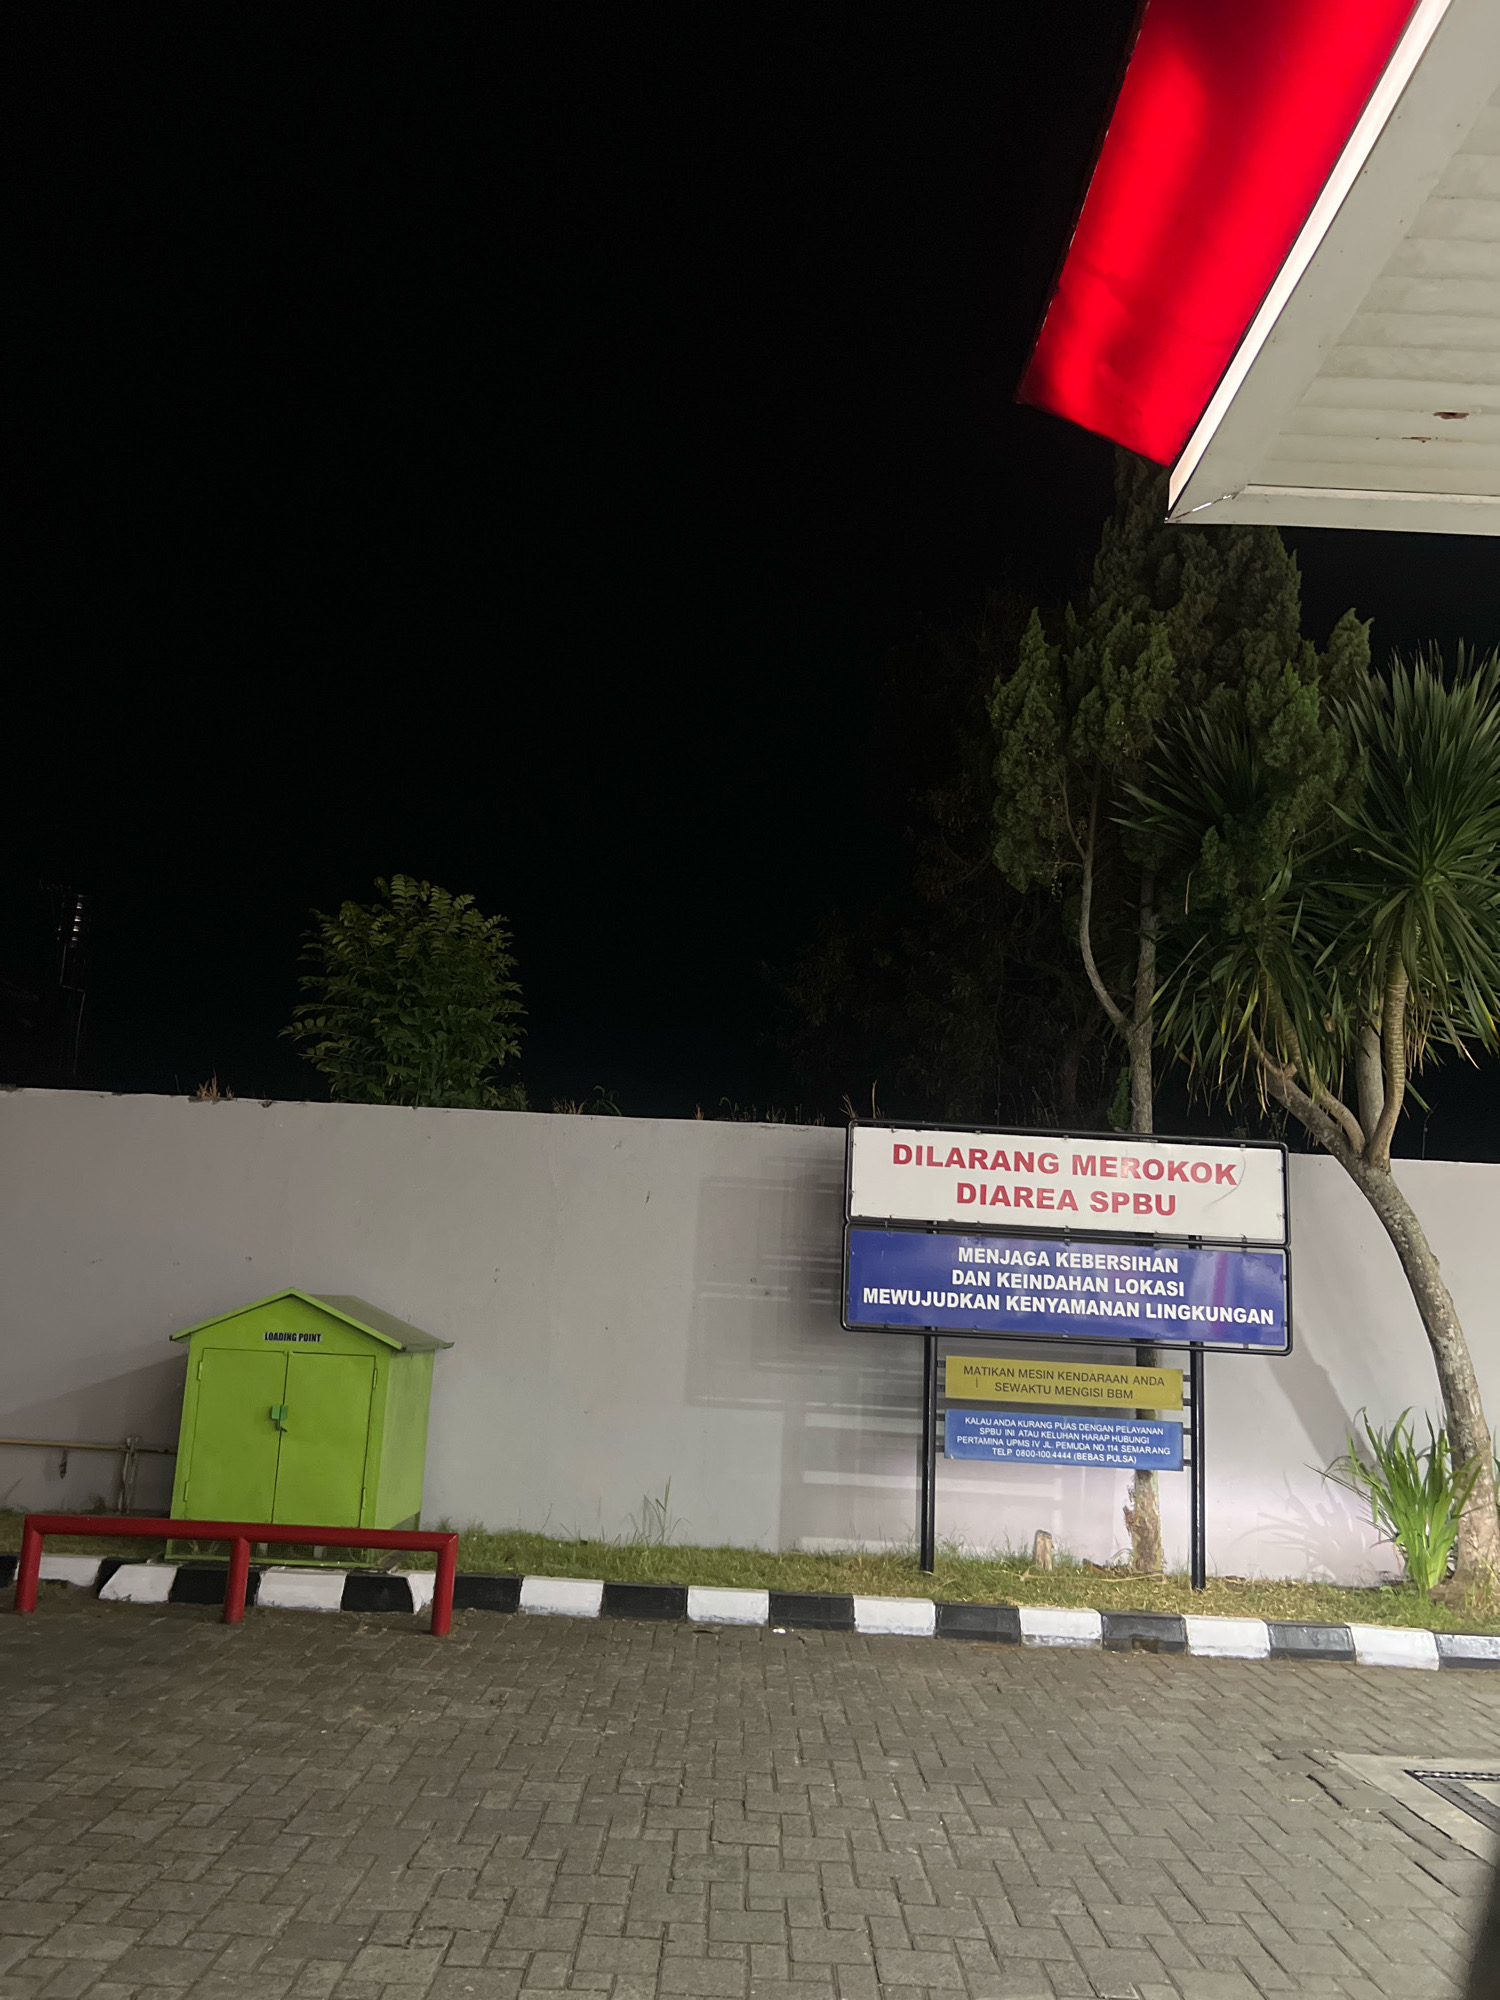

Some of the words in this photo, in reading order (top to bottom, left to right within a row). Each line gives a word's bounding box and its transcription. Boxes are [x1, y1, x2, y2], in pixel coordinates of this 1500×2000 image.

[892, 1143, 1059, 1175] DILARANG
[1071, 1153, 1238, 1186] MEROKOK
[956, 1182, 1079, 1211] DIAREA
[1089, 1190, 1177, 1216] SPBU
[958, 1247, 1050, 1267] MENJAGA
[1055, 1251, 1179, 1274] KEBERSIHAN
[952, 1270, 988, 1287] DAN
[997, 1272, 1110, 1293] KEINDAHAN
[1114, 1278, 1185, 1297] LOKASI
[863, 1287, 1000, 1311] MEWUJUDKAN
[1006, 1294, 1140, 1318] KENYAMANAN
[1145, 1302, 1274, 1326] LINGKUNGAN
[264, 1332, 297, 1342] LOADING
[298, 1333, 322, 1342] POINT
[963, 1365, 1015, 1378] MATIKAN
[1018, 1368, 1054, 1380] MESIN
[1057, 1371, 1129, 1385] KENDARAAN
[1132, 1375, 1165, 1387] ANDA
[994, 1382, 1051, 1395] SEWAKTU
[1054, 1385, 1104, 1398] MENGISI
[1107, 1388, 1134, 1399] BBM
[964, 1417, 992, 1426] KALAU
[993, 1418, 1016, 1427] ANDA
[1017, 1420, 1053, 1429] KURANG
[1054, 1422, 1077, 1431] PUAS
[1078, 1423, 1114, 1433] DENGAN
[1115, 1425, 1164, 1435] PELAYANAN
[979, 1427, 1002, 1436] SPBU
[1004, 1428, 1015, 1436] INI
[1018, 1429, 1039, 1438] ATAU
[1041, 1431, 1079, 1440] KELUHAN
[1081, 1433, 1110, 1442] HARAP
[1111, 1435, 1150, 1444] HUBUNGI
[956, 1435, 1004, 1446] PERTAMINA
[1006, 1438, 1030, 1447] UPMS
[1031, 1440, 1041, 1448] IV
[1055, 1441, 1090, 1450] PEMUDA
[1120, 1445, 1171, 1455] SEMARANG
[1073, 1452, 1105, 1462] (BEBAS
[1106, 1454, 1137, 1464] PULSA)
